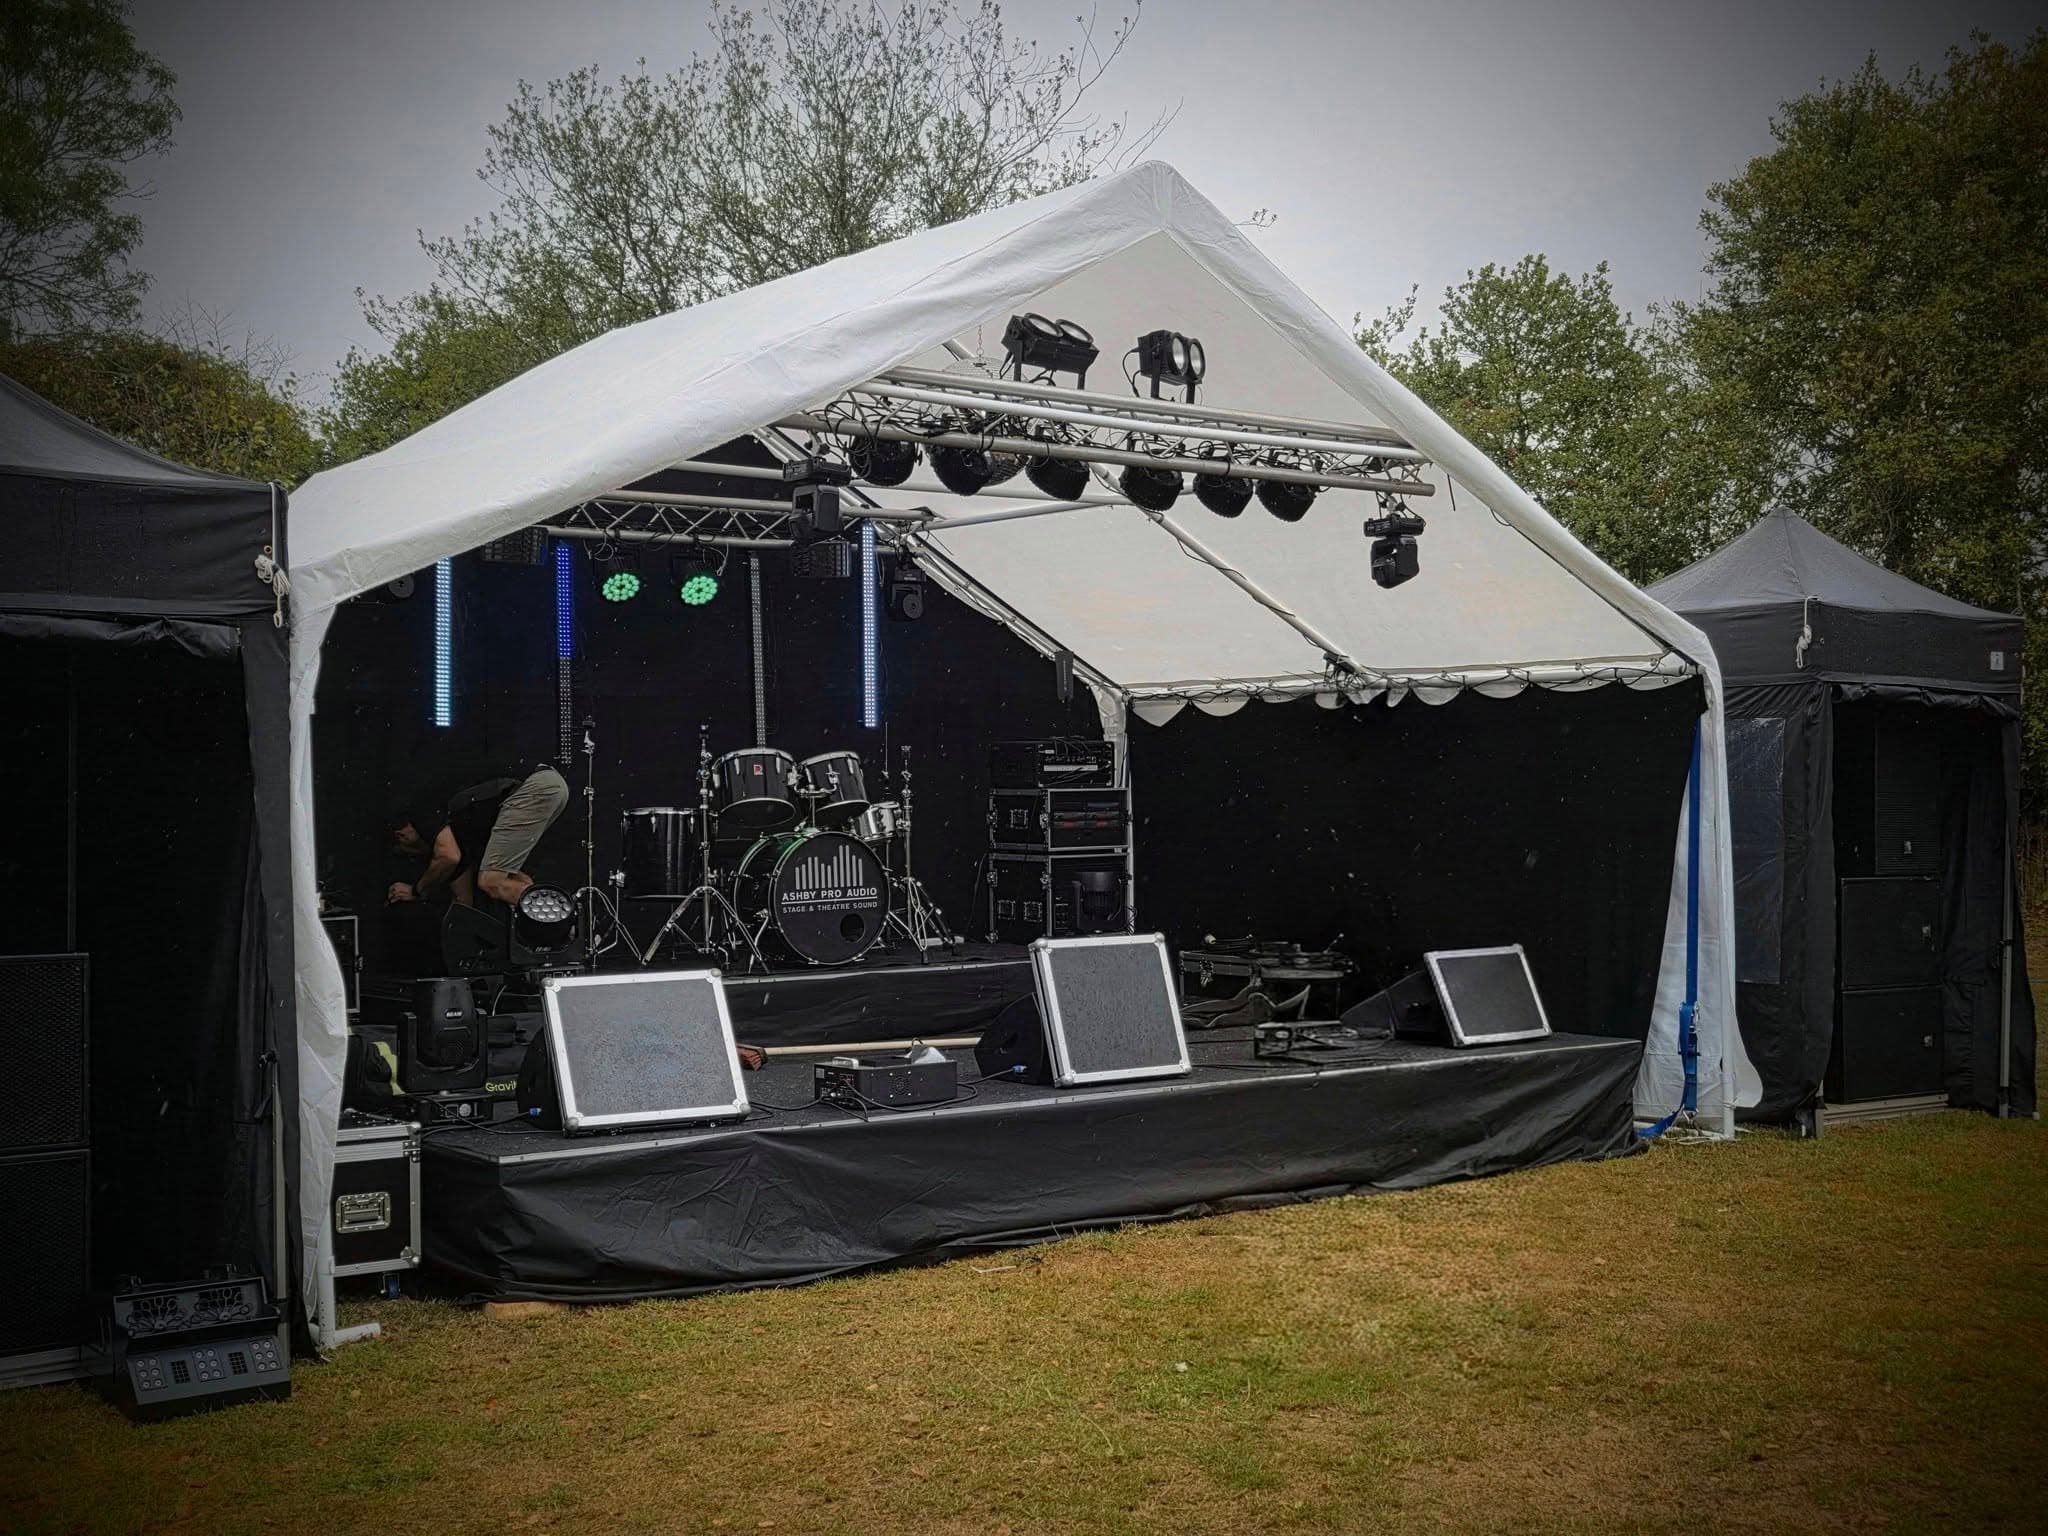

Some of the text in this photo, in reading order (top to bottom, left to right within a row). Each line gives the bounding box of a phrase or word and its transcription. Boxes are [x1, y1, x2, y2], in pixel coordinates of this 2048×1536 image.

[782, 887, 877, 901] ASHBY PRO AUDIO
[783, 905, 806, 914] STAGE
[818, 903, 850, 911] THEATRE
[853, 901, 878, 909] SOUND
